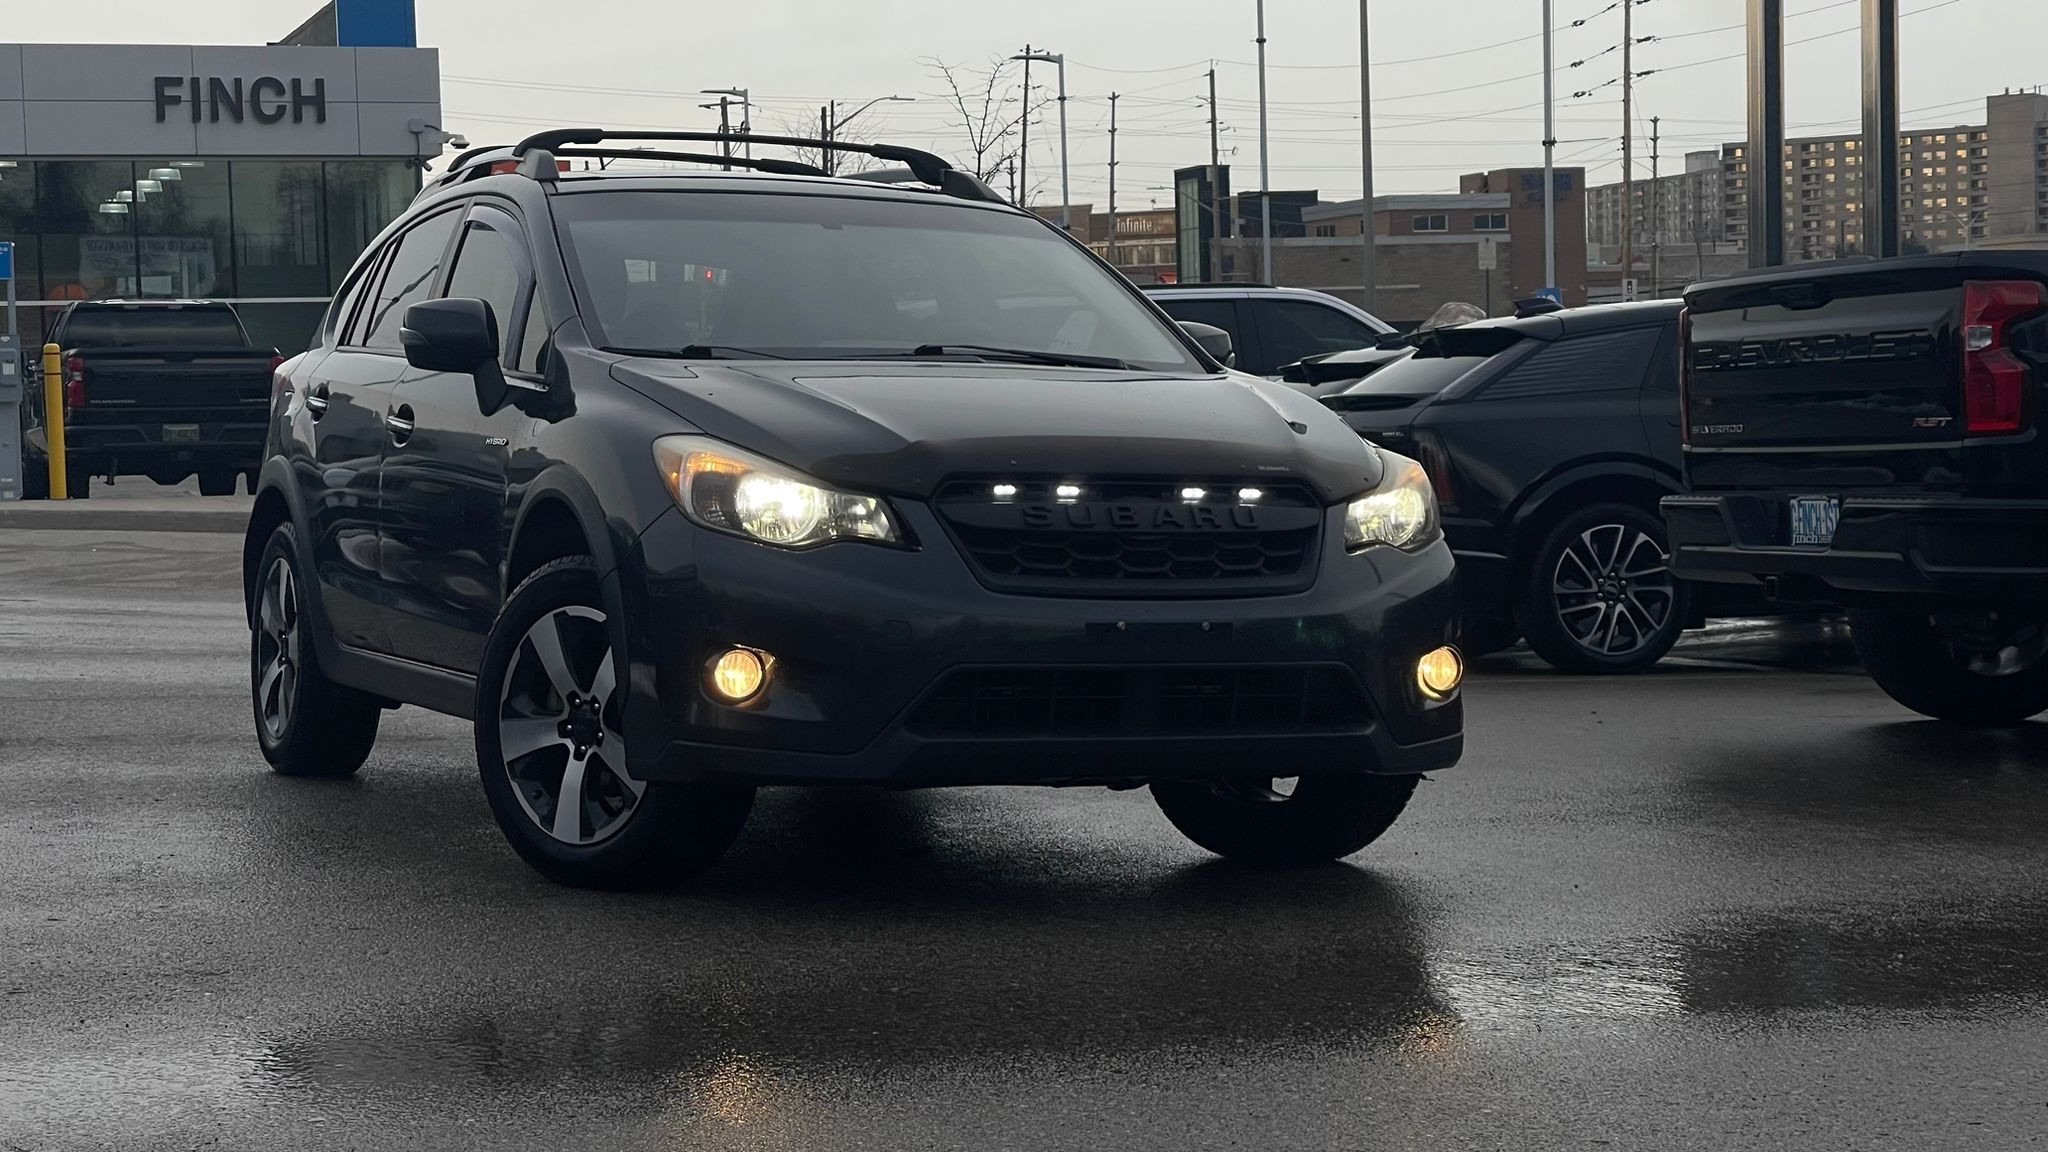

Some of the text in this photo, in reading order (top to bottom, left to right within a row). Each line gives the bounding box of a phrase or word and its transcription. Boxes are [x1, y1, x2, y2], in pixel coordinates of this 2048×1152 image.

[154, 76, 327, 124] FINCH
[1116, 217, 1153, 233] infinite
[1022, 503, 1261, 530] SUBARU
